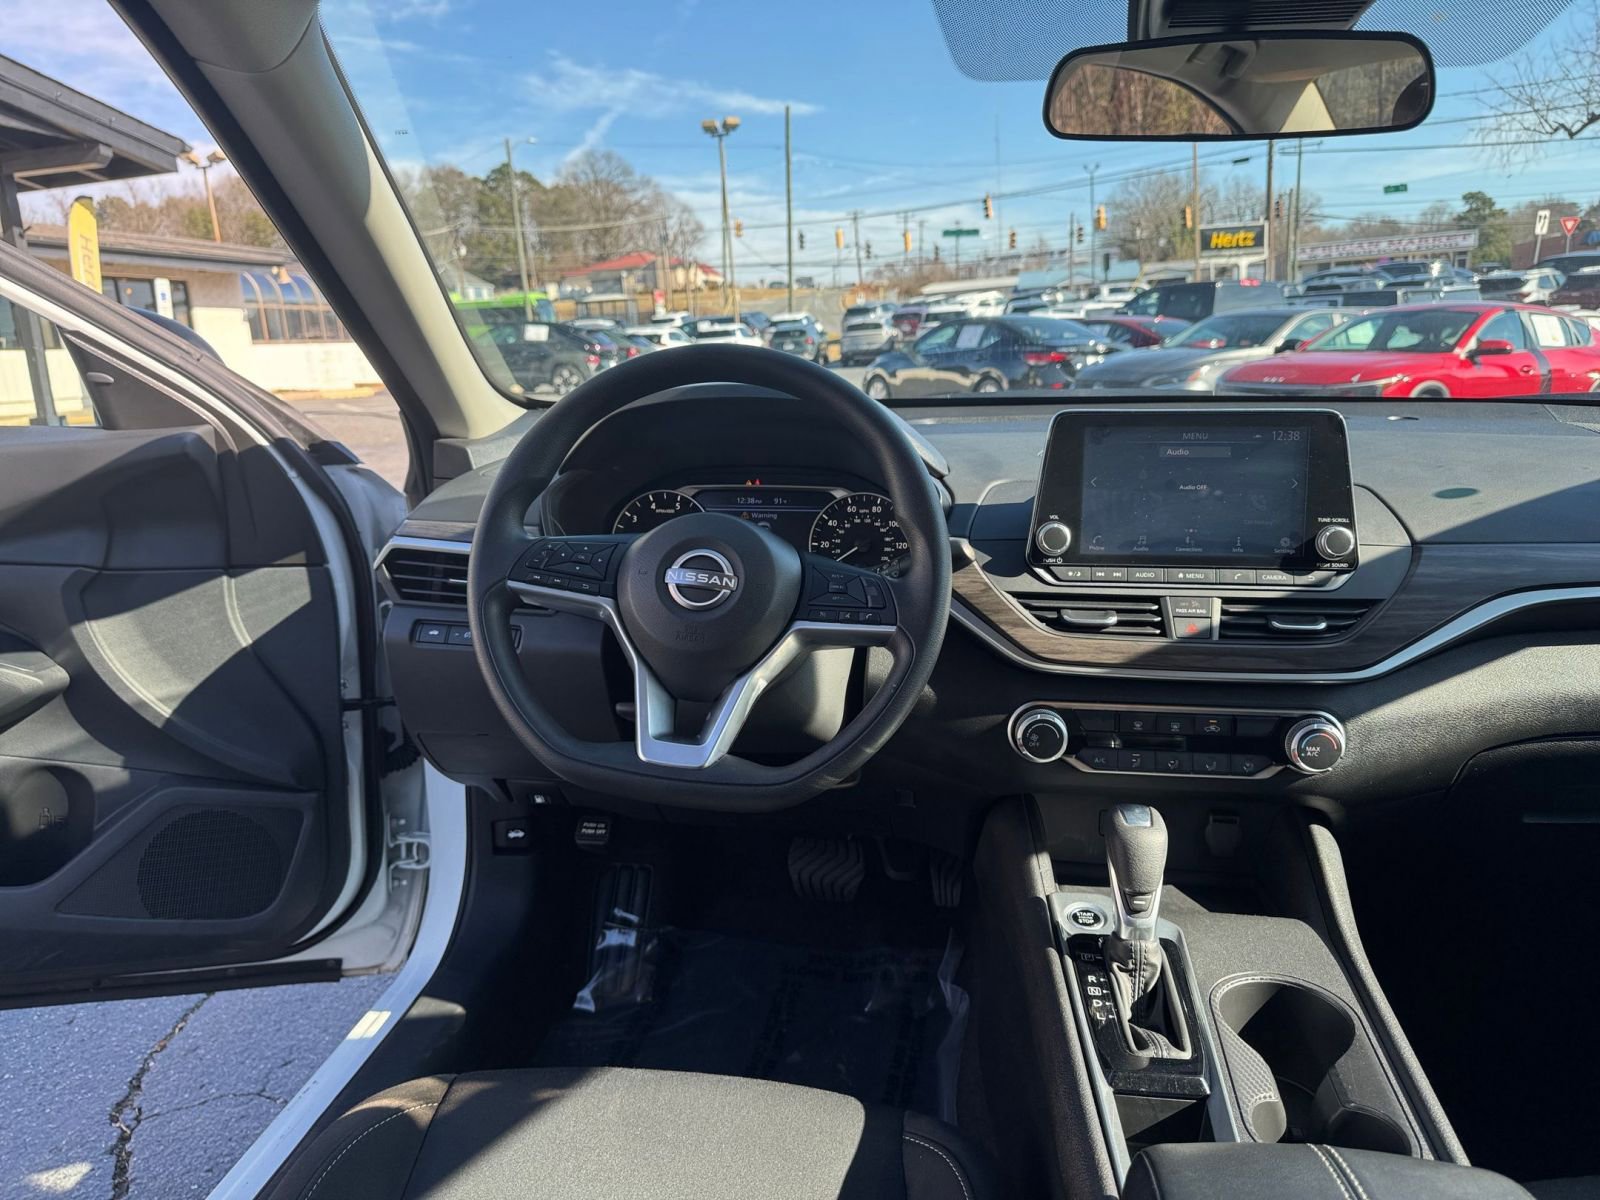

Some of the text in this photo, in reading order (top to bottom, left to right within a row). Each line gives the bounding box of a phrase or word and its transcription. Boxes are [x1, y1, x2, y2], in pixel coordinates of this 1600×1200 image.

[1210, 230, 1256, 249] Hertz
[1182, 432, 1209, 440] MENU
[1271, 431, 1301, 441] 12:38
[1166, 448, 1190, 456] Audio
[650, 502, 656, 510] 4
[675, 502, 681, 510] 5
[632, 515, 638, 523] 3
[751, 511, 778, 520] Warning
[827, 519, 838, 527] 40
[820, 540, 830, 548] 20
[666, 571, 735, 588] NISSAN
[1087, 975, 1097, 983] R
[1096, 1012, 1107, 1020] L
